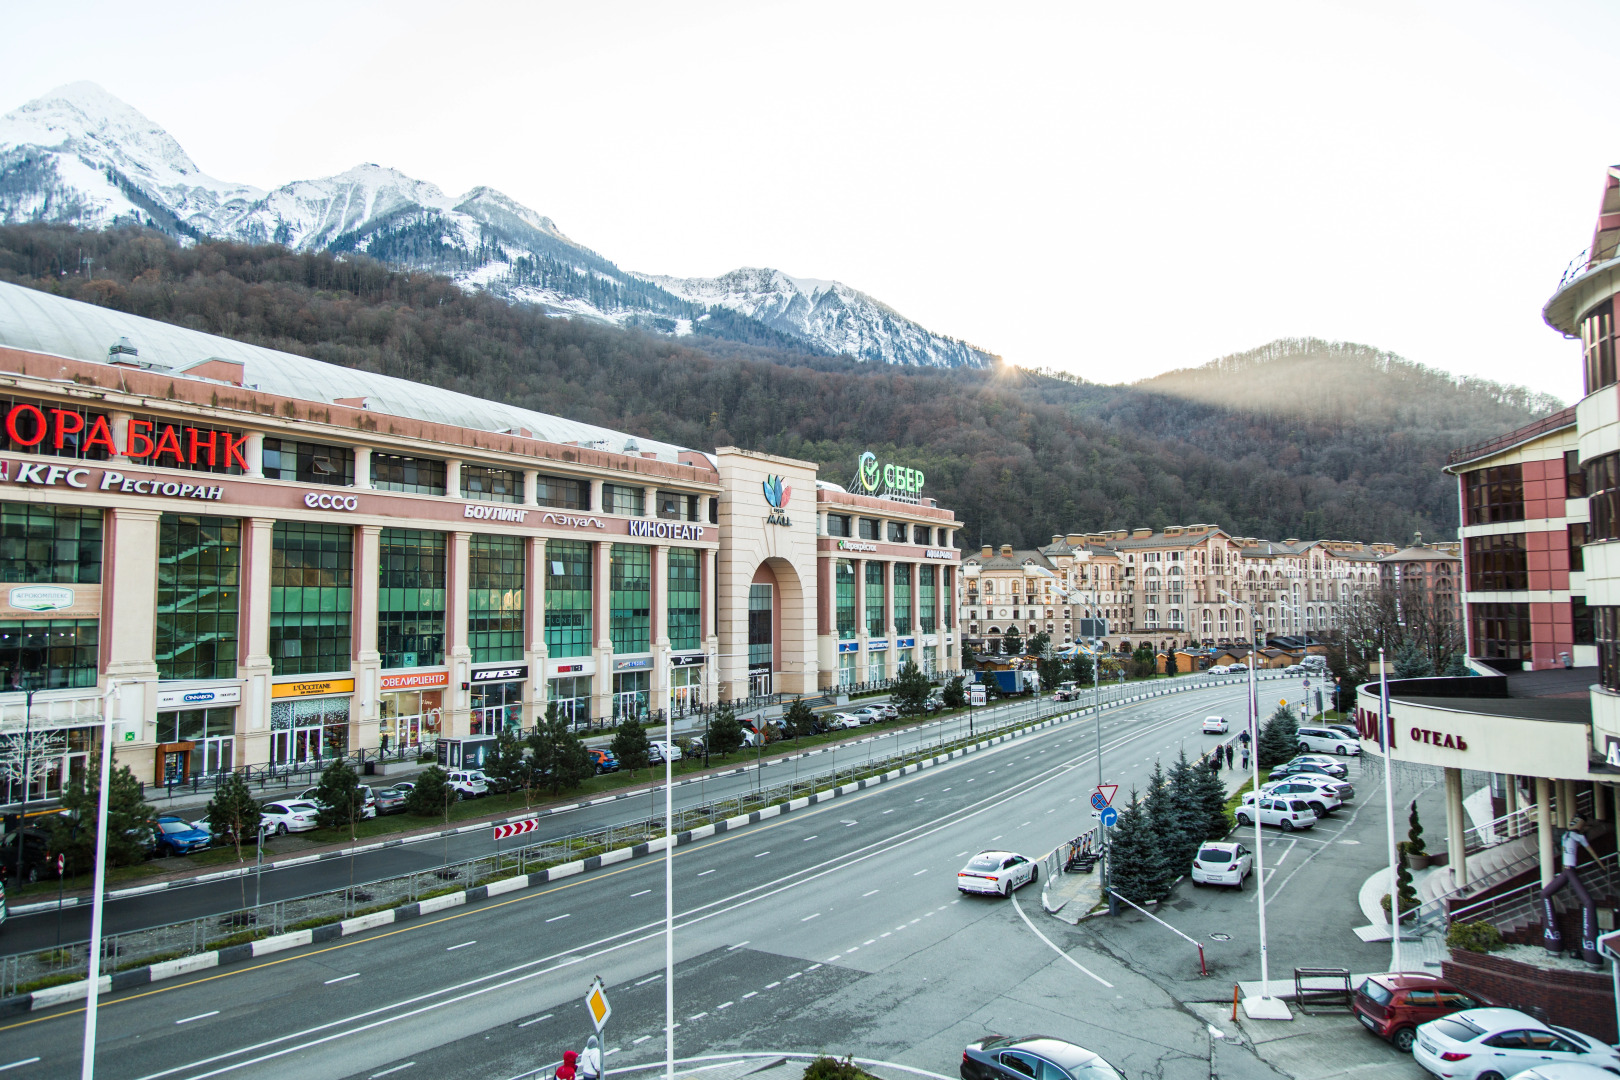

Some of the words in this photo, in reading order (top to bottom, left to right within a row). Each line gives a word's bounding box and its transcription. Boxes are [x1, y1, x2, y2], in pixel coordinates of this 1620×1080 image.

[15, 462, 91, 488] KFC
[884, 463, 925, 493] СБЕР
[304, 492, 358, 511] ecco
[464, 504, 529, 523] БОУЛИНГ
[766, 514, 793, 527] MALL
[629, 520, 704, 541] КИНОТЕАТР
[474, 668, 522, 680] DAINESE
[293, 683, 331, 691] L'OCCITANE
[185, 693, 213, 701] CINNABON
[1410, 727, 1467, 751] ОТЕЛЬ
